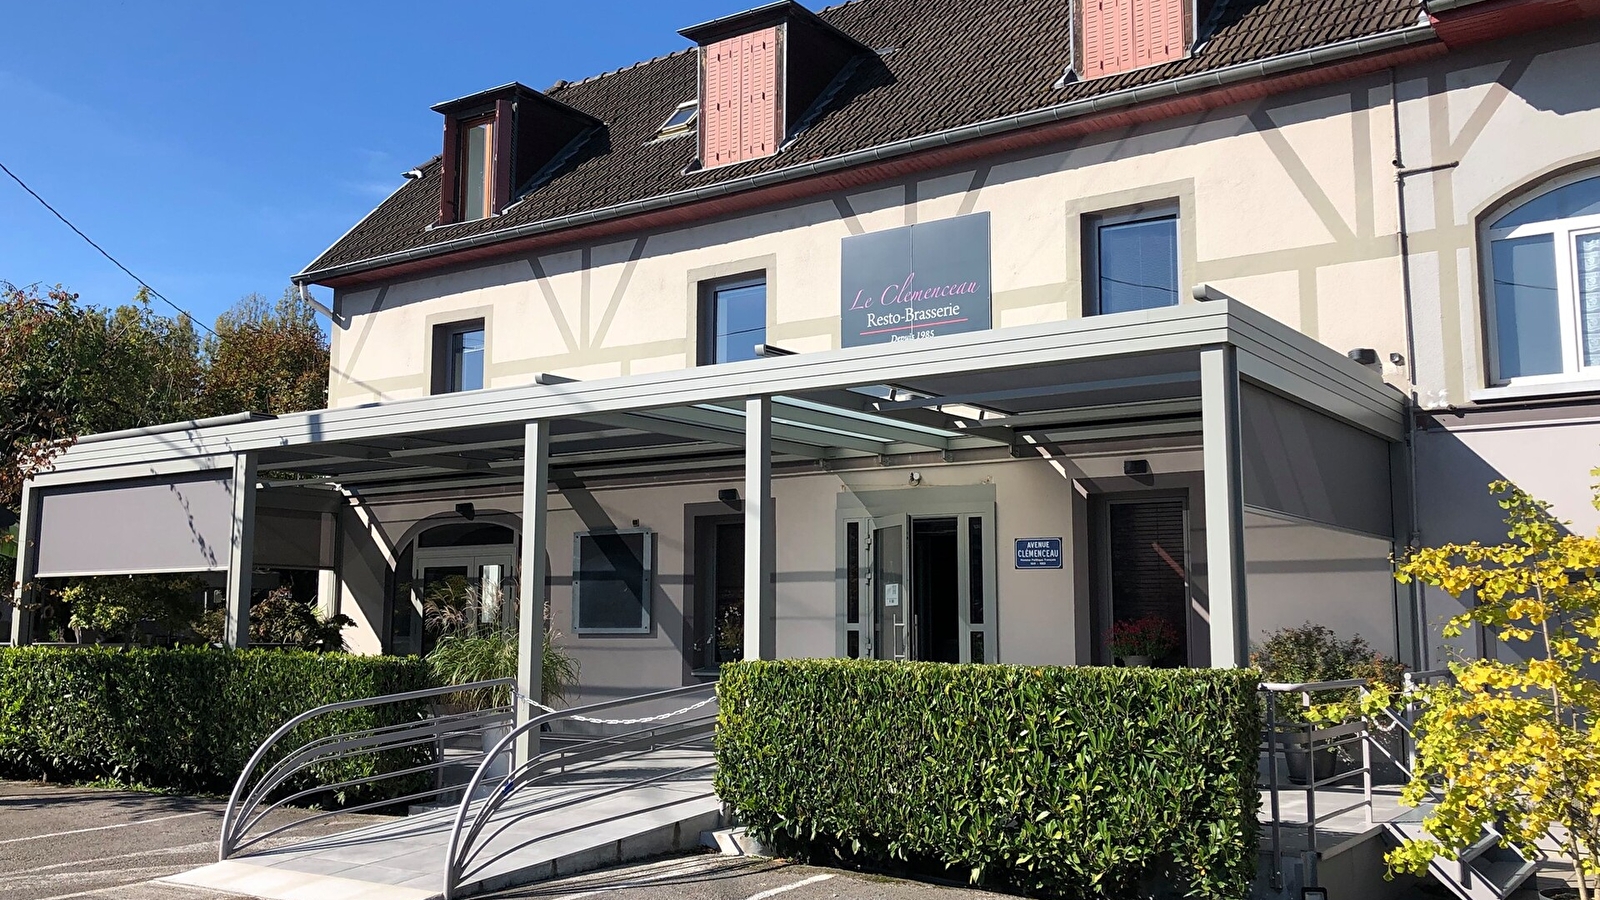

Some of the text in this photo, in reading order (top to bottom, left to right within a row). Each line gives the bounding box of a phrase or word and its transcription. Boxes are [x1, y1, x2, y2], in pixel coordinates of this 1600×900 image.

[849, 289, 874, 311] Le
[867, 303, 960, 328] Resto-Brasserie
[917, 329, 935, 340] 1985
[1027, 541, 1050, 549] AVENUE
[1017, 548, 1059, 558] CLÉMENCEAU
